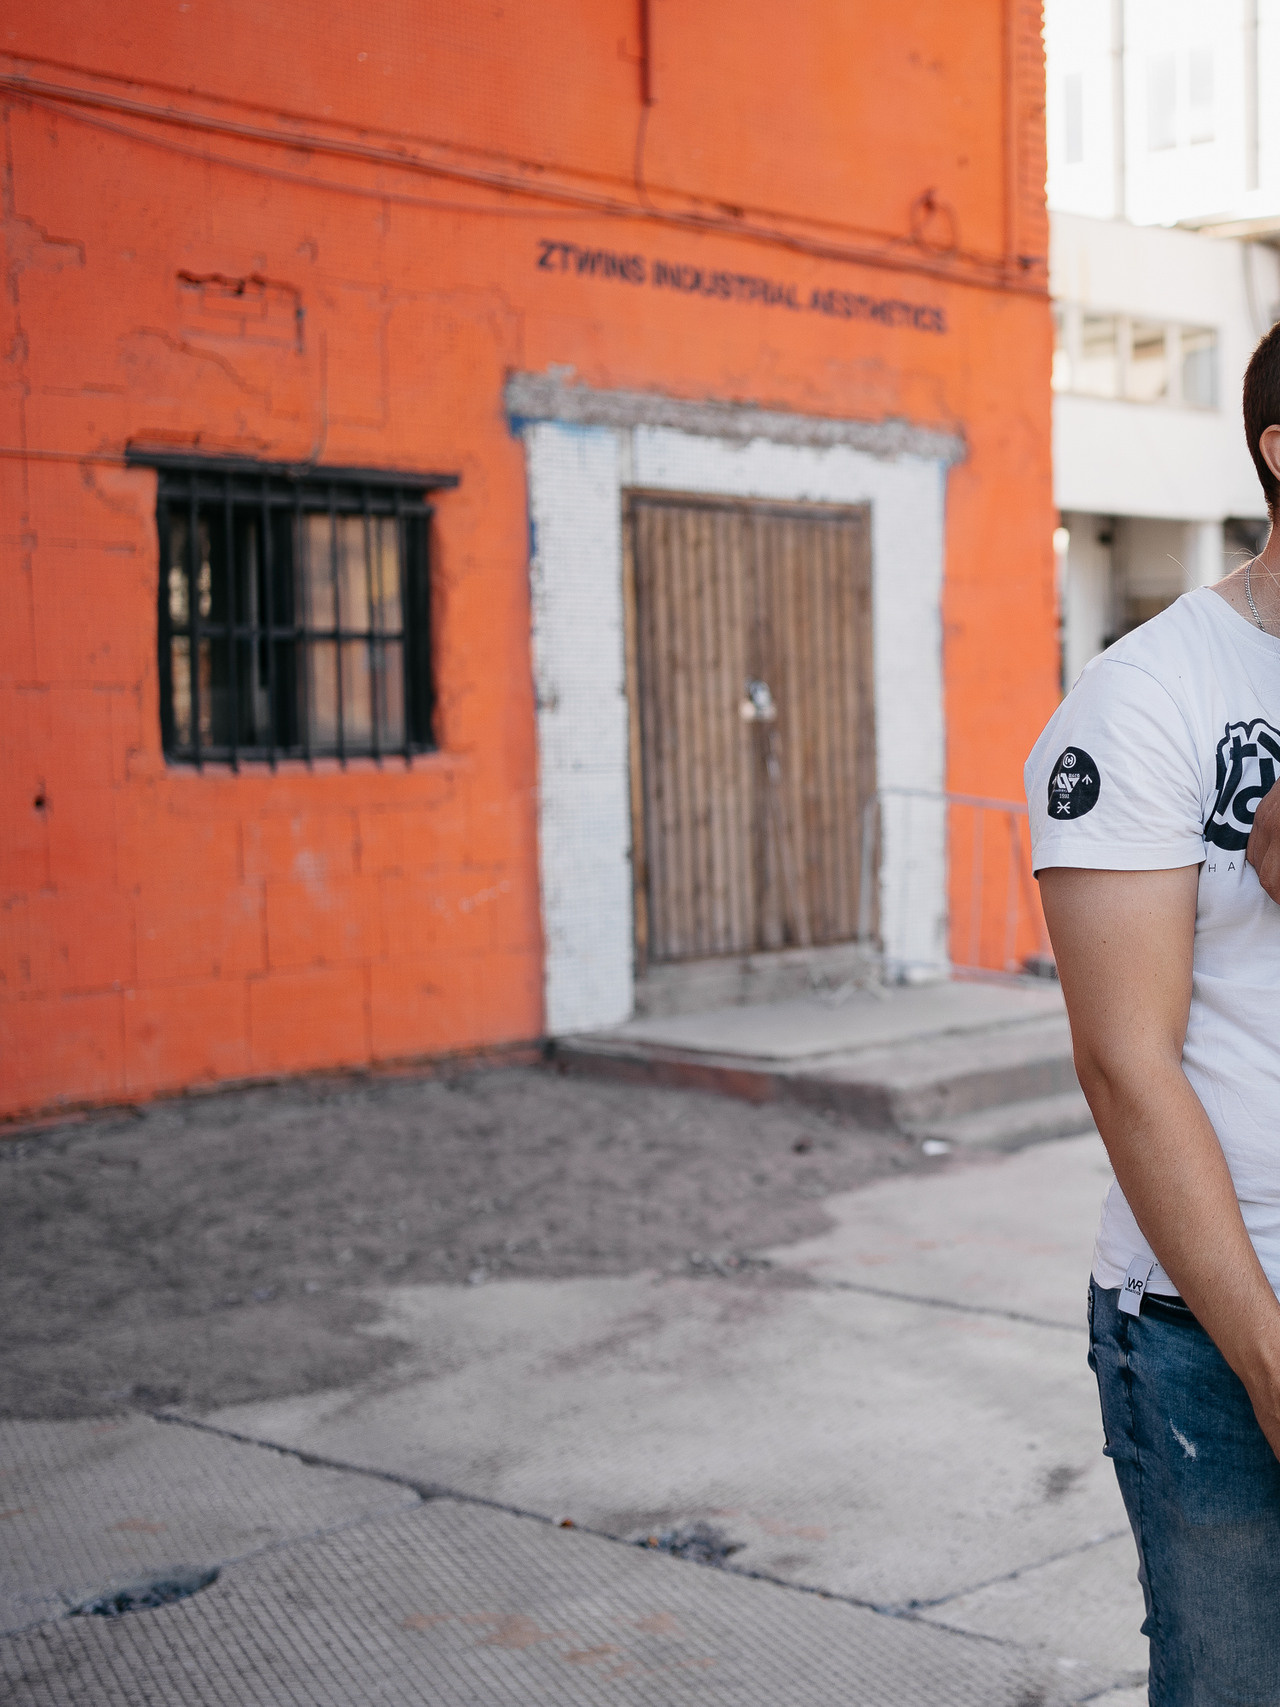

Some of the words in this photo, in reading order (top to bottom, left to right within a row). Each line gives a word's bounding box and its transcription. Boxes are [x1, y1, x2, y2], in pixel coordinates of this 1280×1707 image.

[536, 239, 647, 285] ZTWINS
[651, 260, 801, 311] INDUSTRIAL
[808, 289, 947, 335] AESTHETICS
[1127, 1276, 1144, 1292] WR
